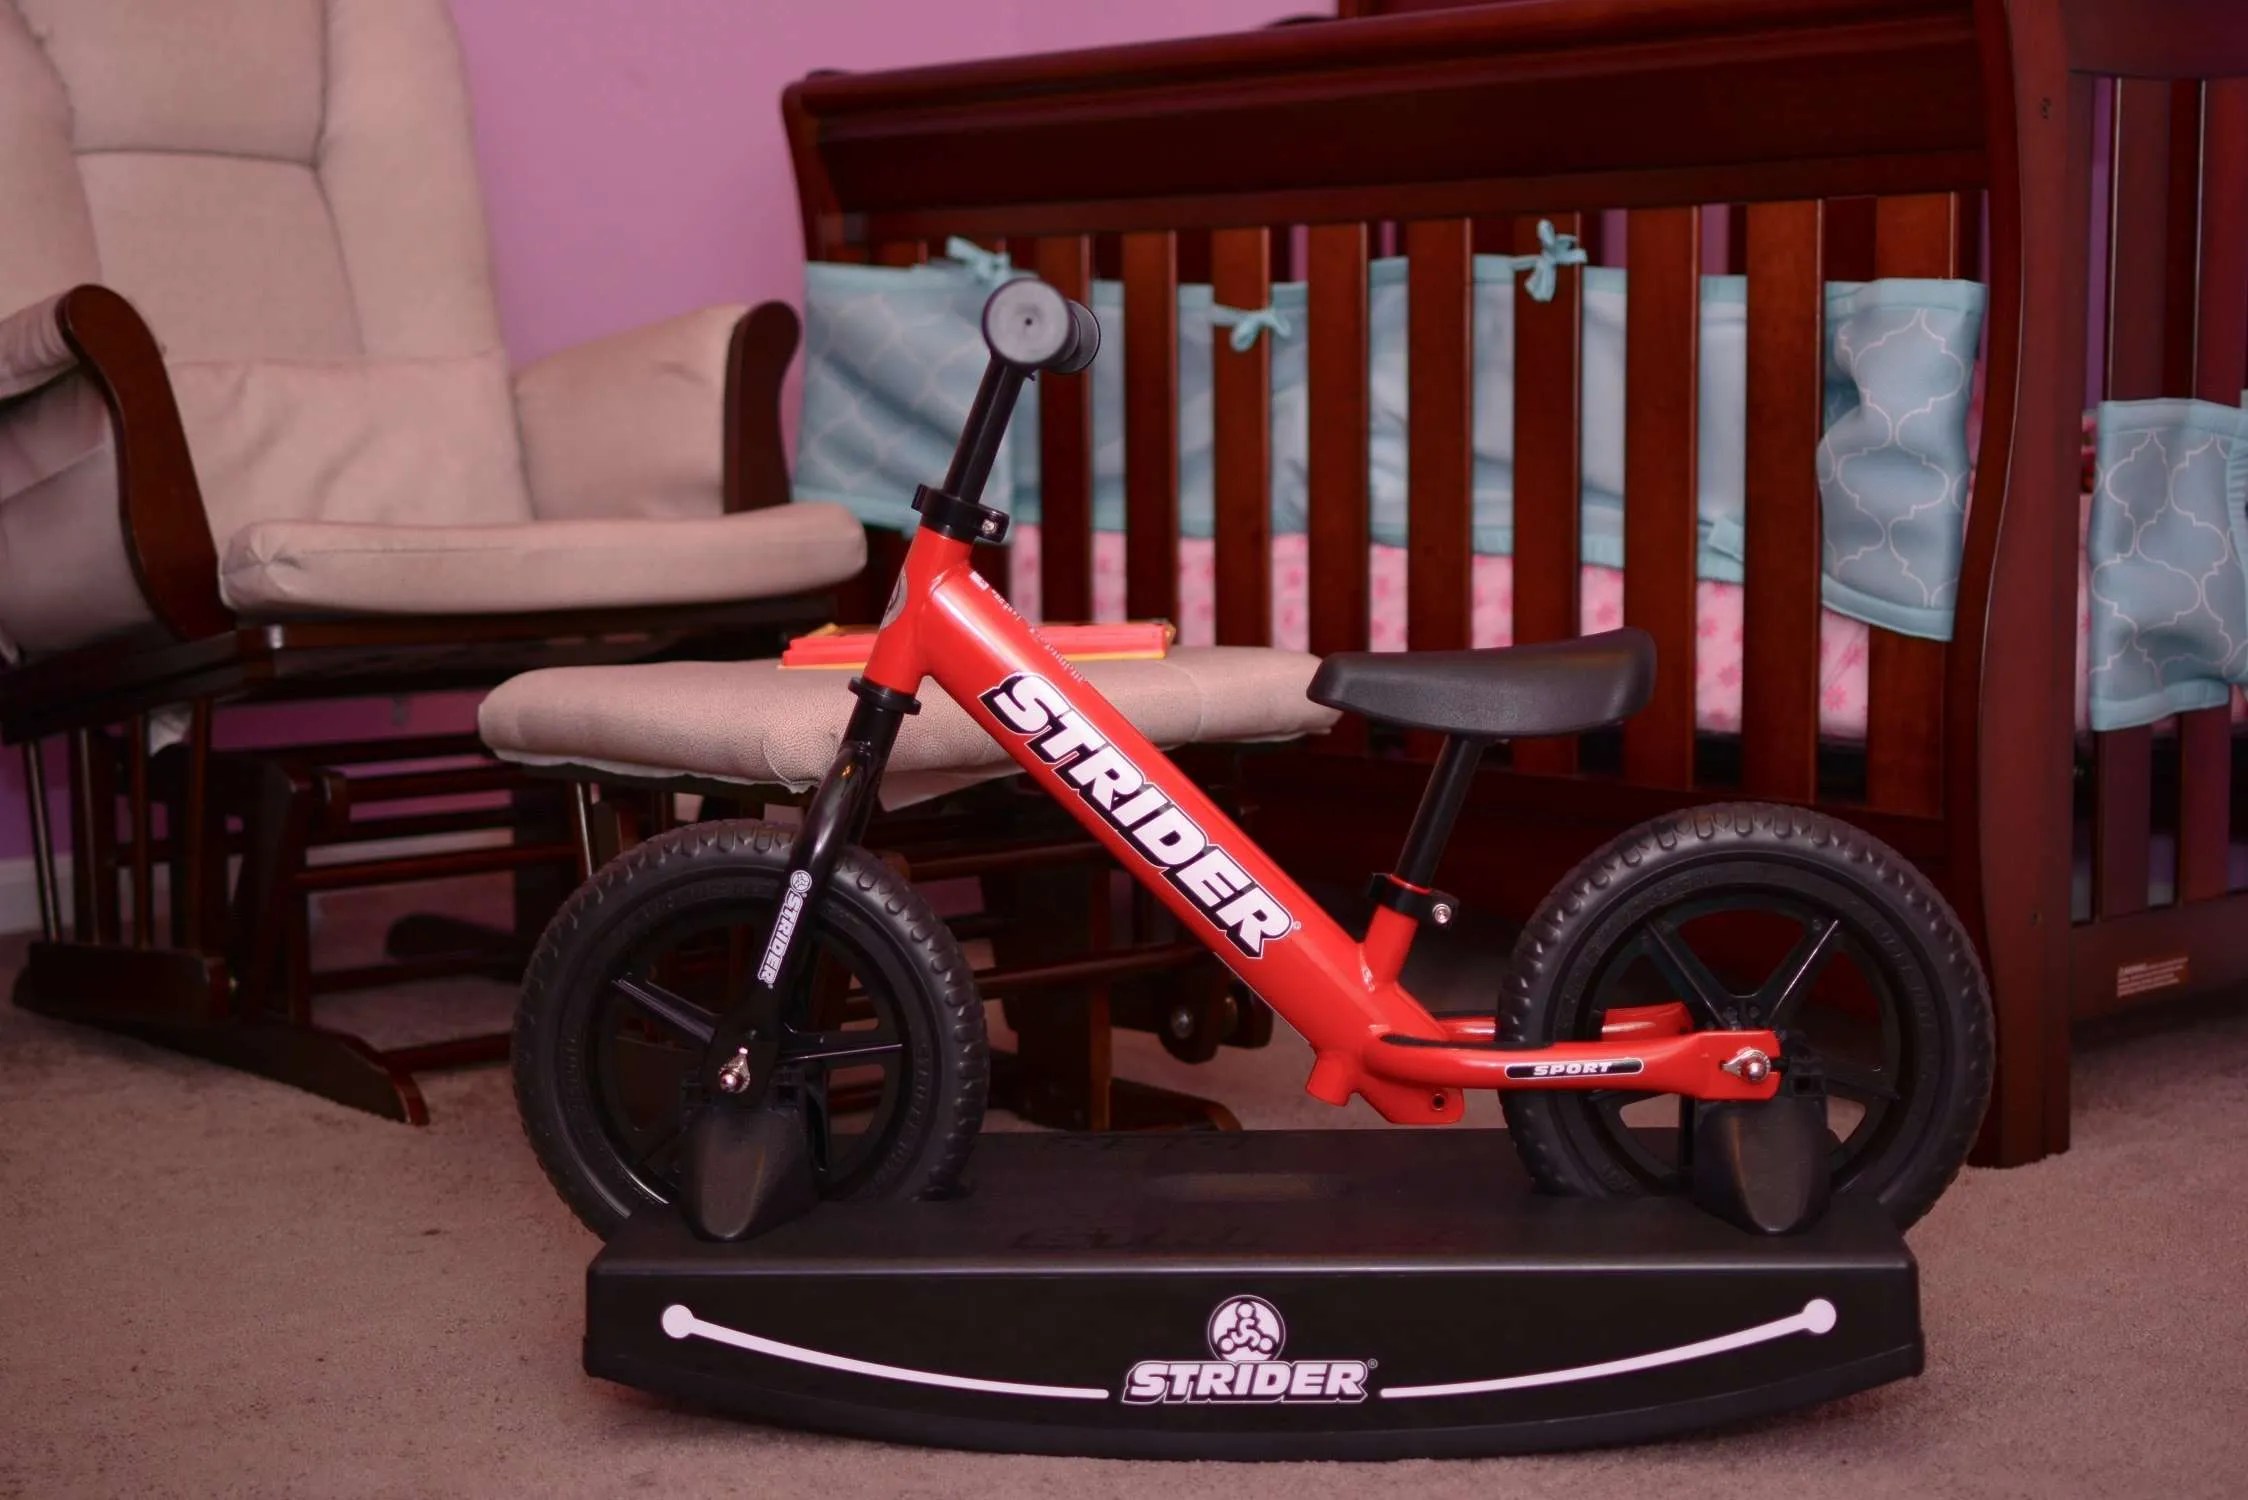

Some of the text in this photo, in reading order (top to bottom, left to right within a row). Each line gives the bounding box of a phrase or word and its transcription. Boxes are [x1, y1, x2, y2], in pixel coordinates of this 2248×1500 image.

[978, 672, 1293, 959] STRIDER
[757, 888, 804, 984] STRIDER
[1532, 1061, 1612, 1076] SPORT
[1122, 1359, 1368, 1404] STRIDER
